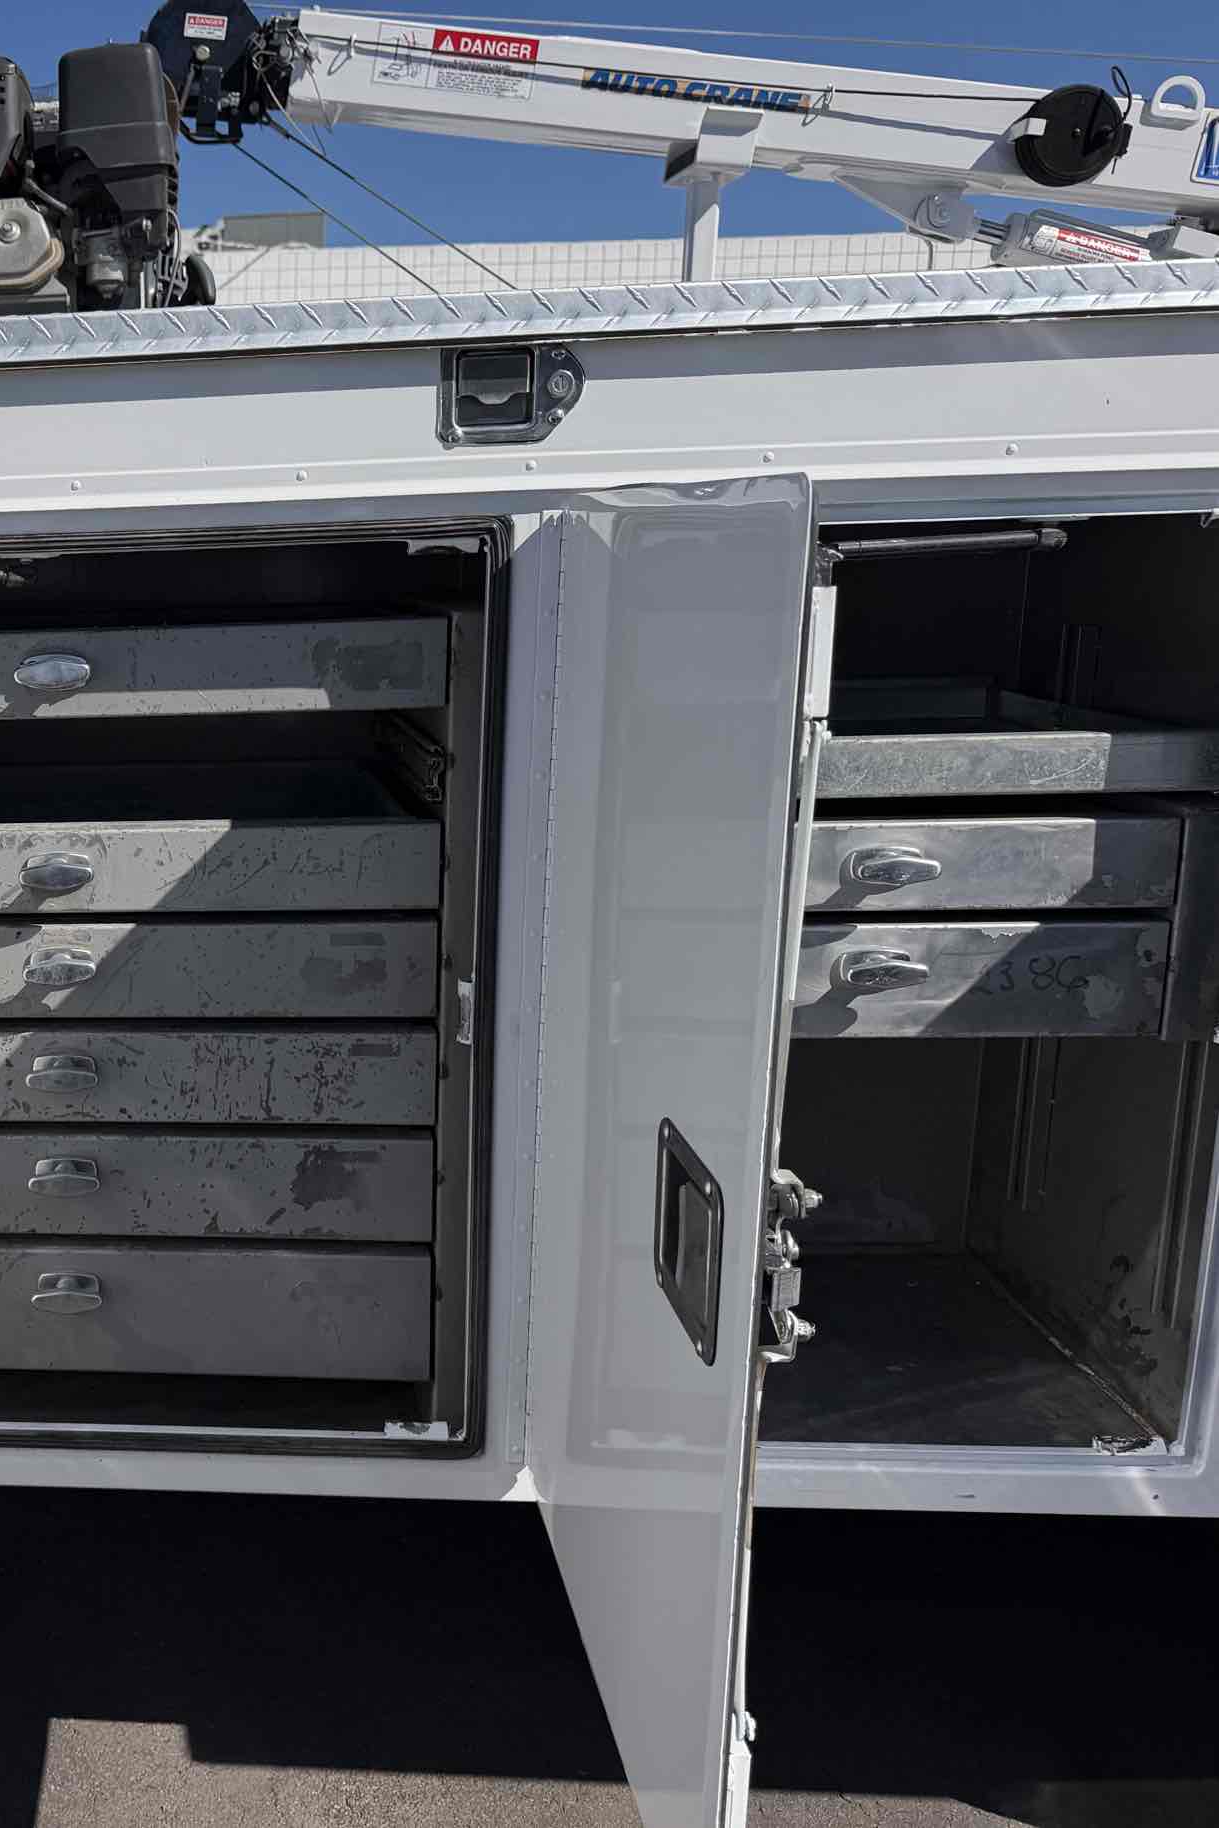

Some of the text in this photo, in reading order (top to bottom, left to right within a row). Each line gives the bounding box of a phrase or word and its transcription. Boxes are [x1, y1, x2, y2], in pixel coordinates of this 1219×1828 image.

[459, 37, 532, 59] DANGER
[586, 69, 803, 111] AUTO CRANE
